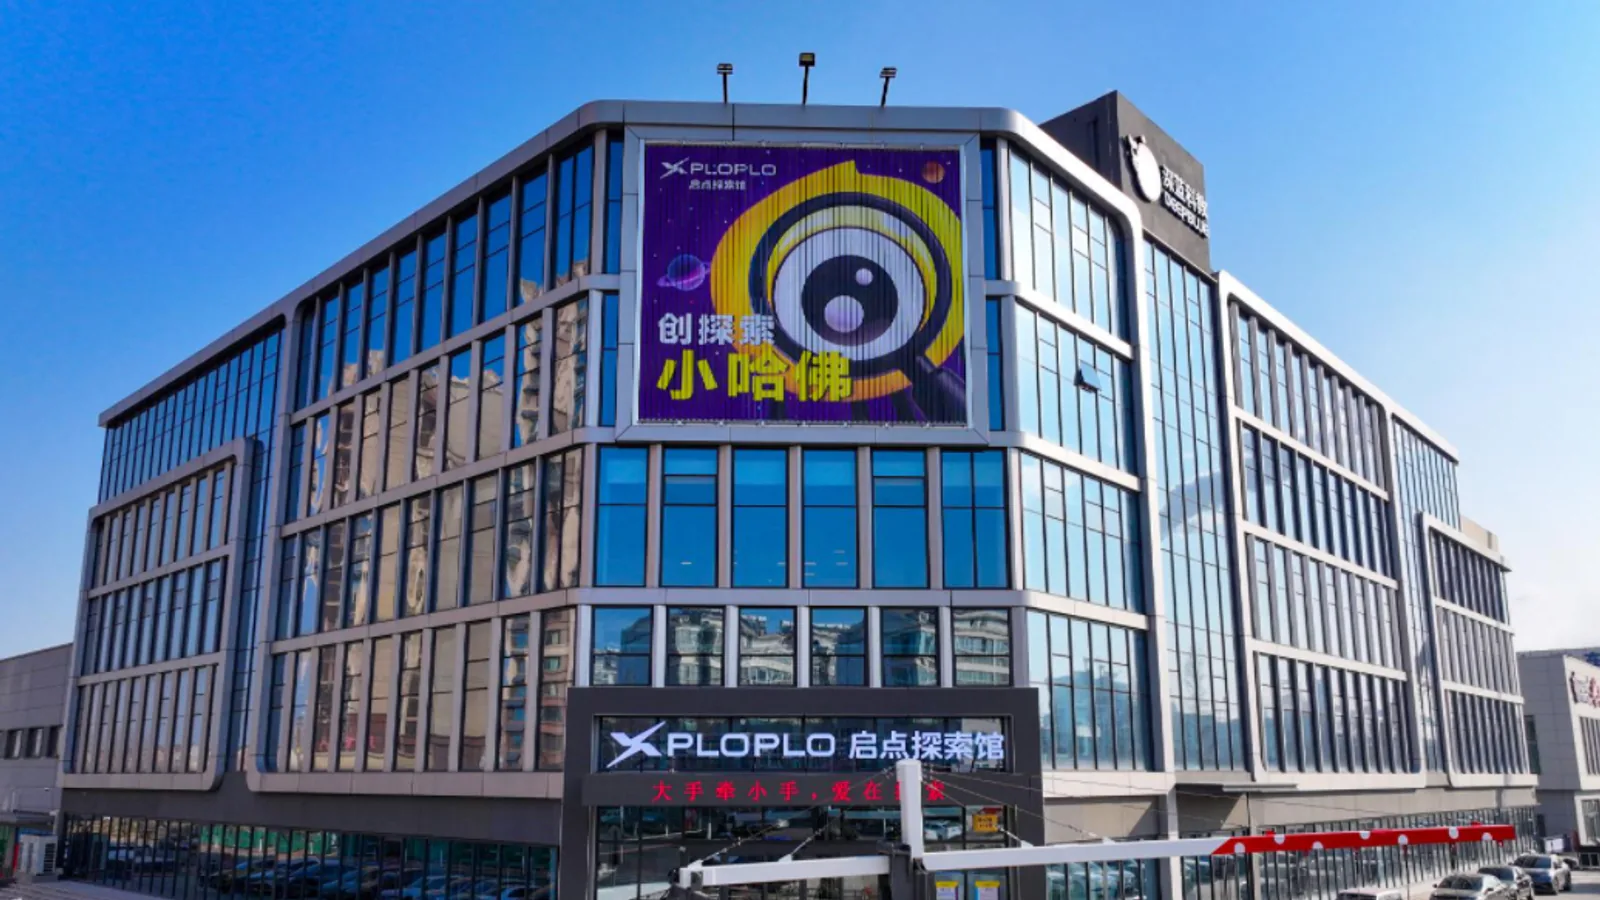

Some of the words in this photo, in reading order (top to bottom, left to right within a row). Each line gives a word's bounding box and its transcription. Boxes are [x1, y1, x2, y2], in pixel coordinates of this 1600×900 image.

[658, 312, 776, 346] 创探索
[656, 343, 852, 402] 小哈佛
[848, 730, 1005, 761] 启点探索馆
